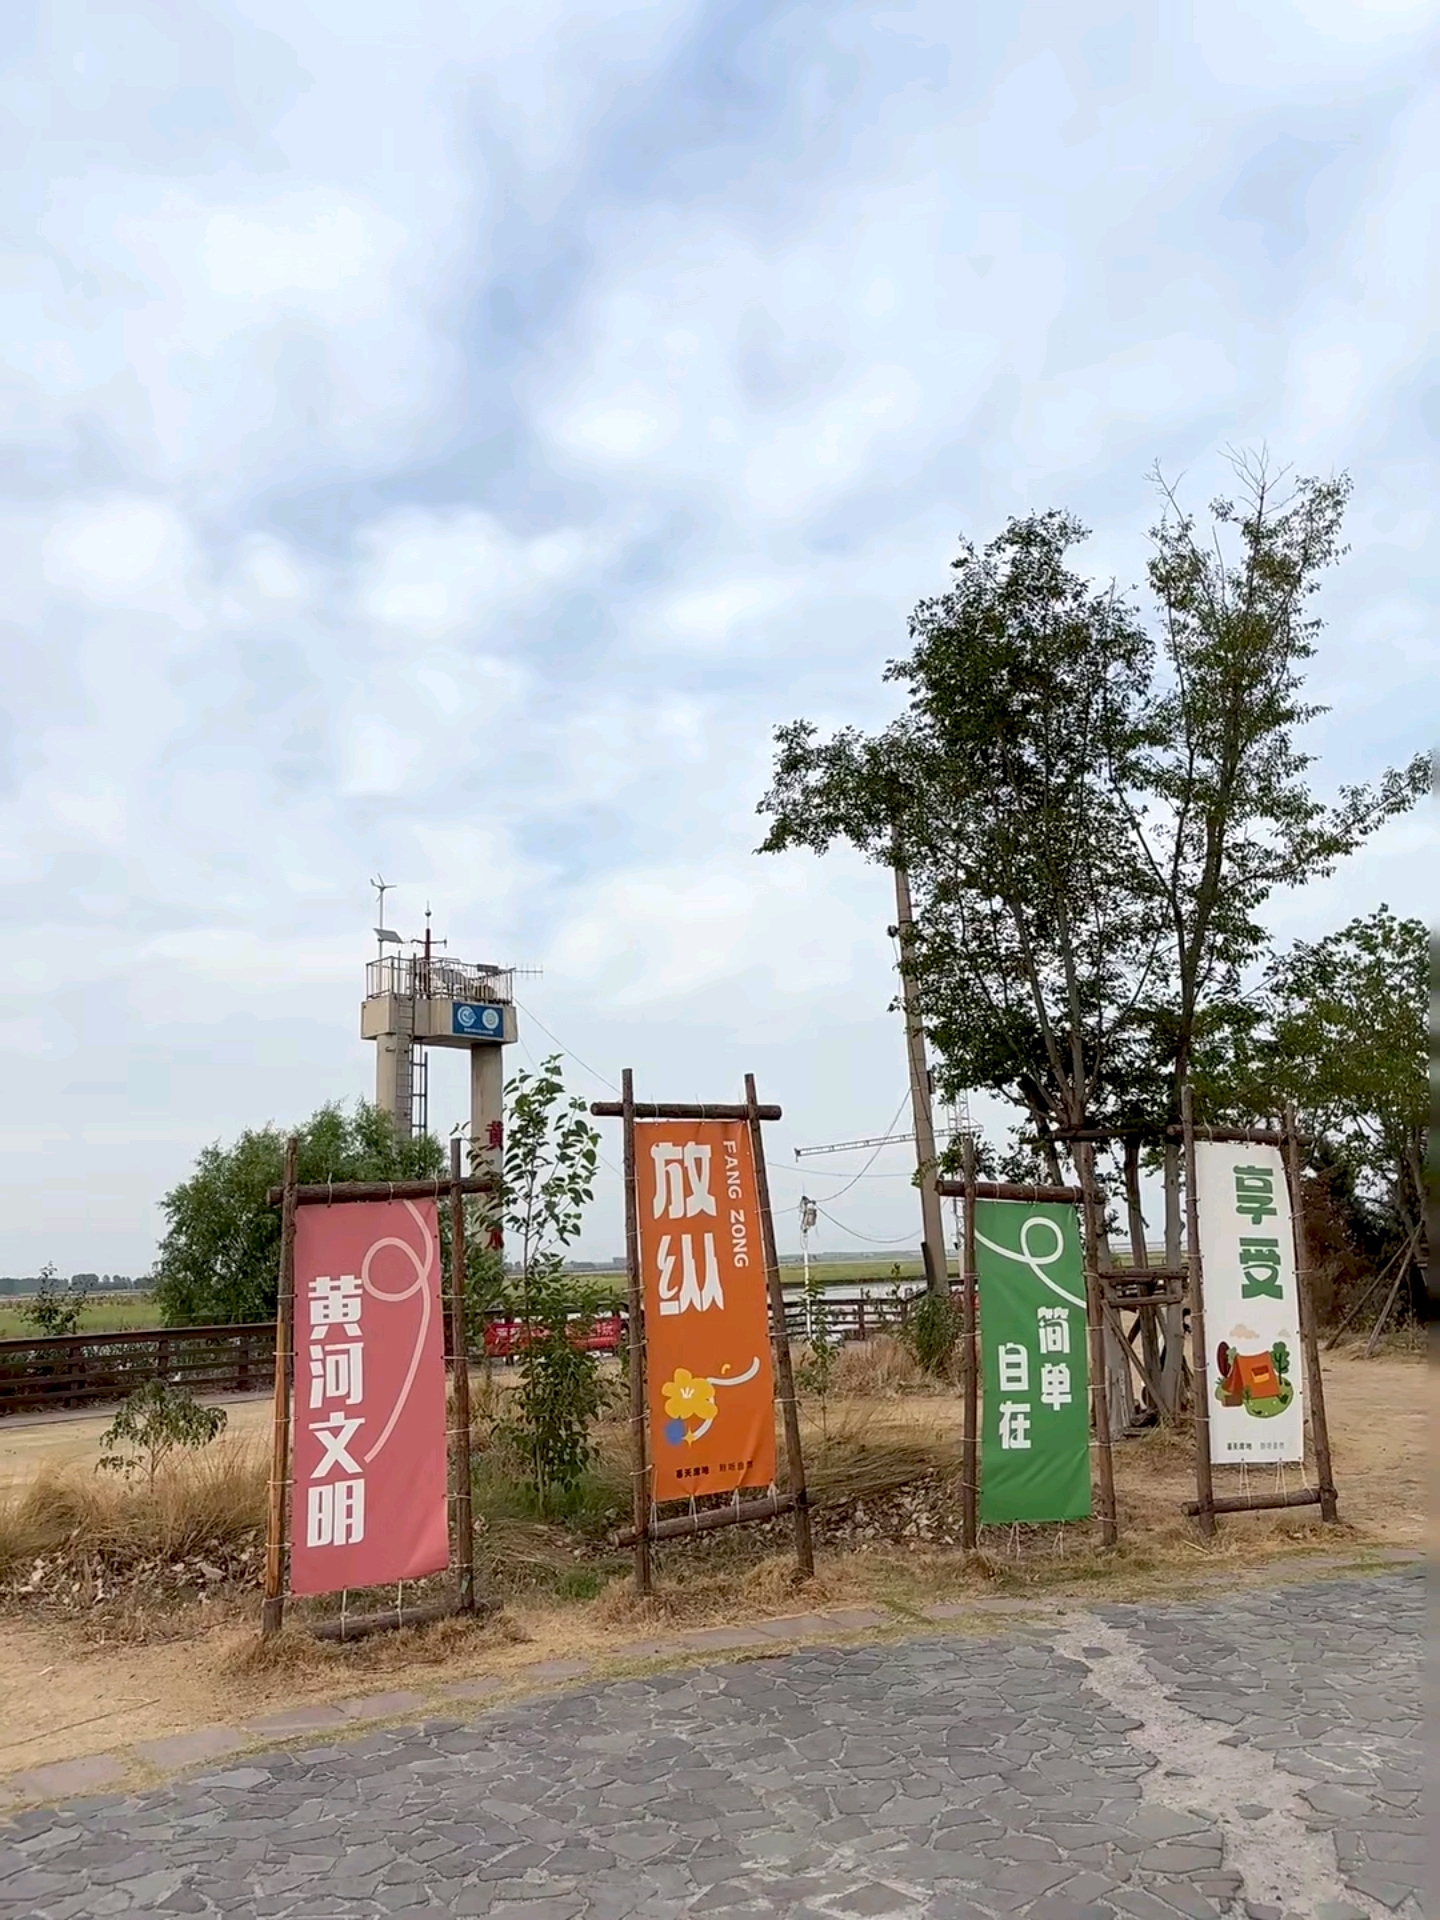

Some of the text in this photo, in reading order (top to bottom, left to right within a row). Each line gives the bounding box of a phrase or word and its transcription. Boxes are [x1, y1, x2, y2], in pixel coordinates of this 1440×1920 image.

[650, 1141, 724, 1316] 放纵
[723, 1140, 749, 1268] FANG ZONG
[1233, 1165, 1283, 1300] 享受
[306, 1275, 366, 1548] 黄河文明
[998, 1342, 1031, 1449] 自在
[1037, 1306, 1072, 1411] 简单
